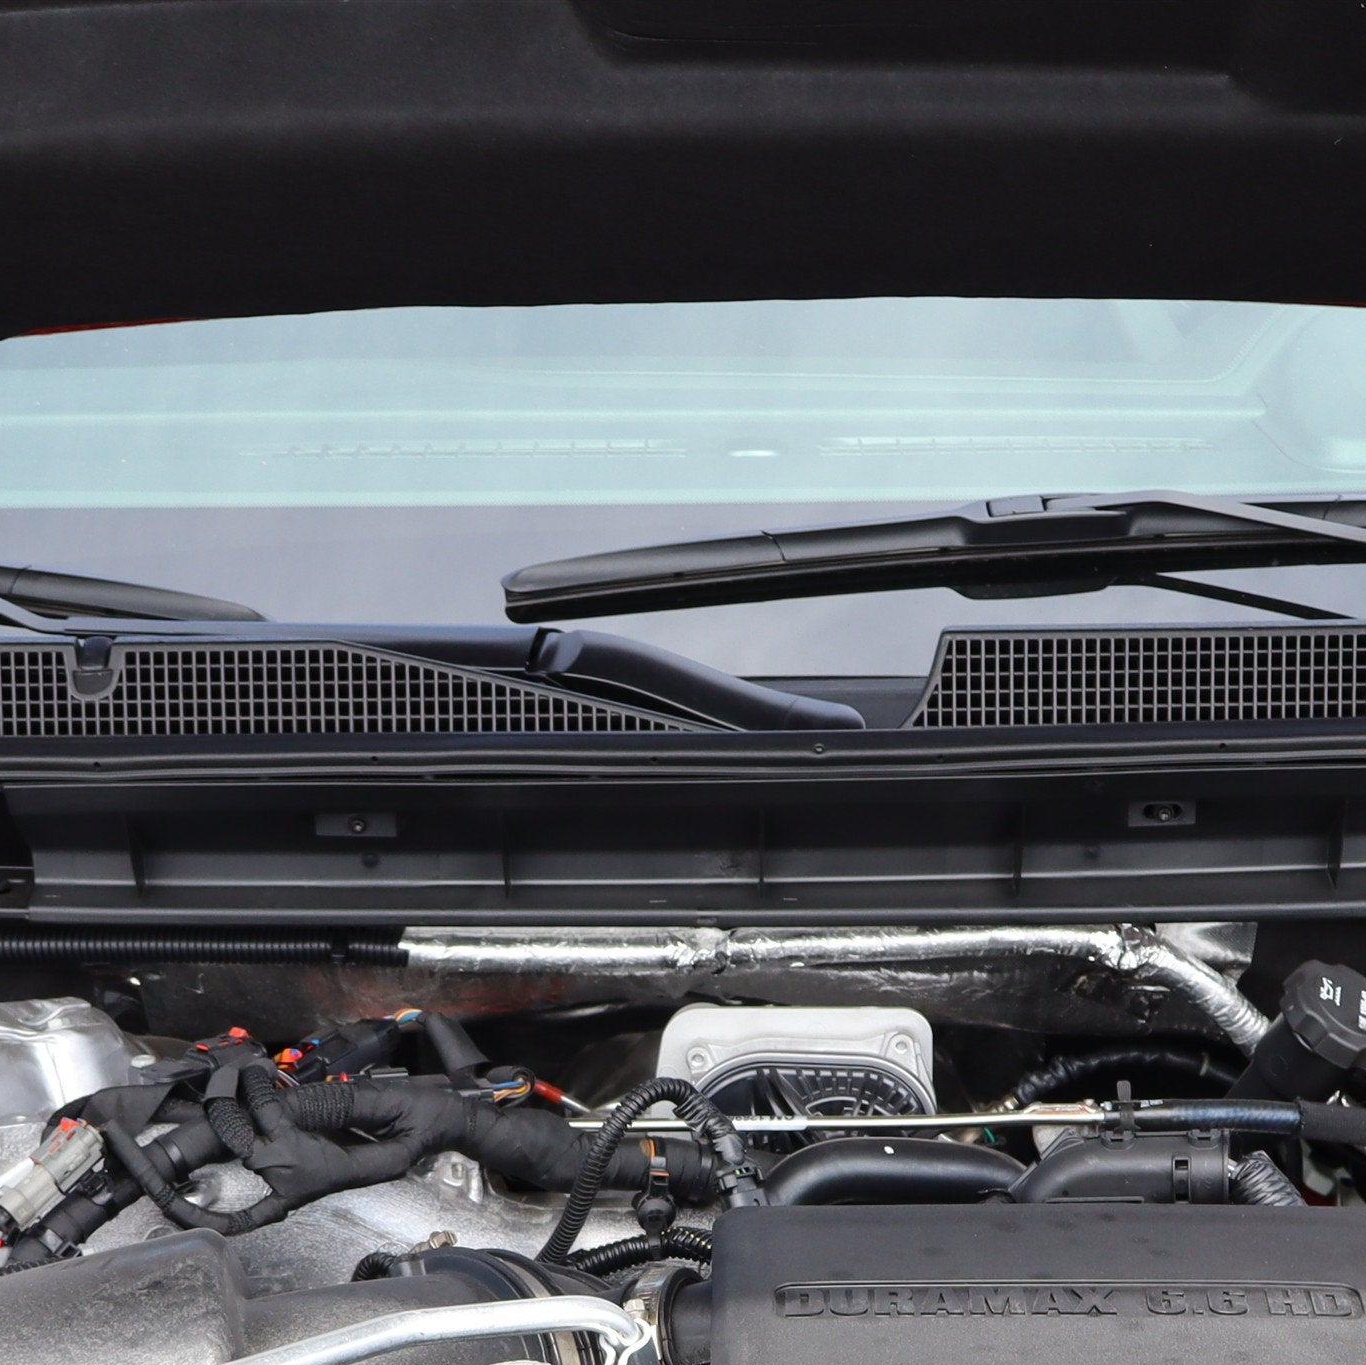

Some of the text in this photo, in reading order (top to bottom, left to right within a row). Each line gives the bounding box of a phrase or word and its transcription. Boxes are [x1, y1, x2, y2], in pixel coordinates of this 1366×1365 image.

[783, 1286, 1353, 1317] DURAMAX 6.6 HD
